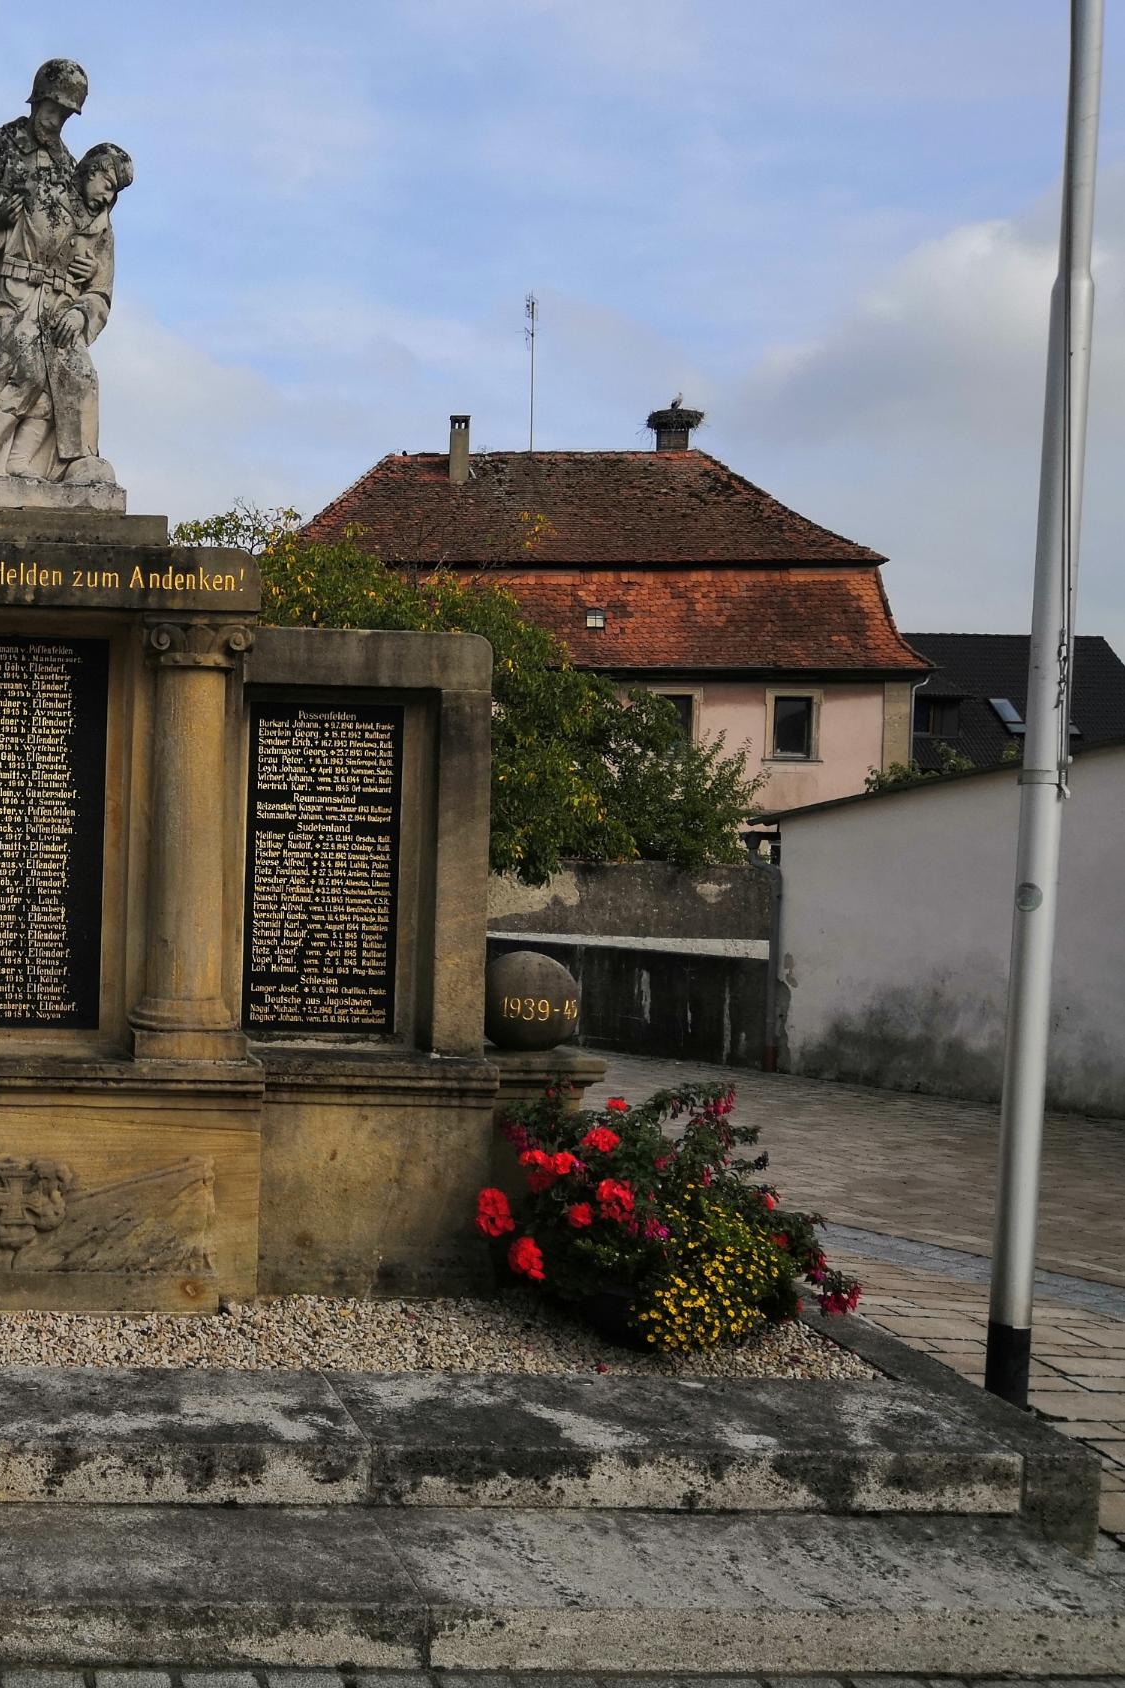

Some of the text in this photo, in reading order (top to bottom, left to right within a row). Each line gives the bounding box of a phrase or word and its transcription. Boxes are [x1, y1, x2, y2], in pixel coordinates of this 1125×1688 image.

[72, 568, 119, 588] zum
[129, 564, 245, 592] Andenken!
[298, 710, 356, 721] Possenfelden
[259, 718, 321, 728] Burkard Johann.
[295, 728, 321, 739] Georg.
[259, 736, 313, 746] Sendner Erich.
[0, 752, 16, 761] Göb
[304, 746, 328, 757] Georg.
[258, 754, 306, 764] Grau Peter.
[258, 763, 332, 775] Leyh Johann. April
[257, 780, 287, 790] Hertrich
[291, 781, 311, 791] Karl.
[294, 794, 356, 804] Reumannswind
[297, 823, 350, 832] Sudetenland
[288, 831, 315, 840] Gustav.
[288, 840, 312, 850] Rudolf.
[256, 848, 280, 857] Fischer
[283, 858, 308, 866] Alfred.
[372, 861, 388, 869] Polen
[255, 874, 287, 884] Drescher
[254, 892, 277, 901] Nausch
[254, 901, 305, 911] Franke Alfred.
[253, 919, 302, 929] Schmidt Karl.
[253, 928, 310, 938] Schmidt Rudolf.
[252, 937, 304, 946] Nausch Josef.
[274, 946, 299, 955] Josef.
[325, 947, 340, 957] April
[252, 954, 296, 964] Vogel Paul.
[300, 976, 338, 984] Schlesien
[251, 983, 299, 994] Langer Josef.
[265, 995, 301, 1004] Deutsche
[324, 998, 372, 1007] Jugoslawien
[502, 996, 578, 1021] 1939-45
[250, 1012, 304, 1022] Bogner Johann.
